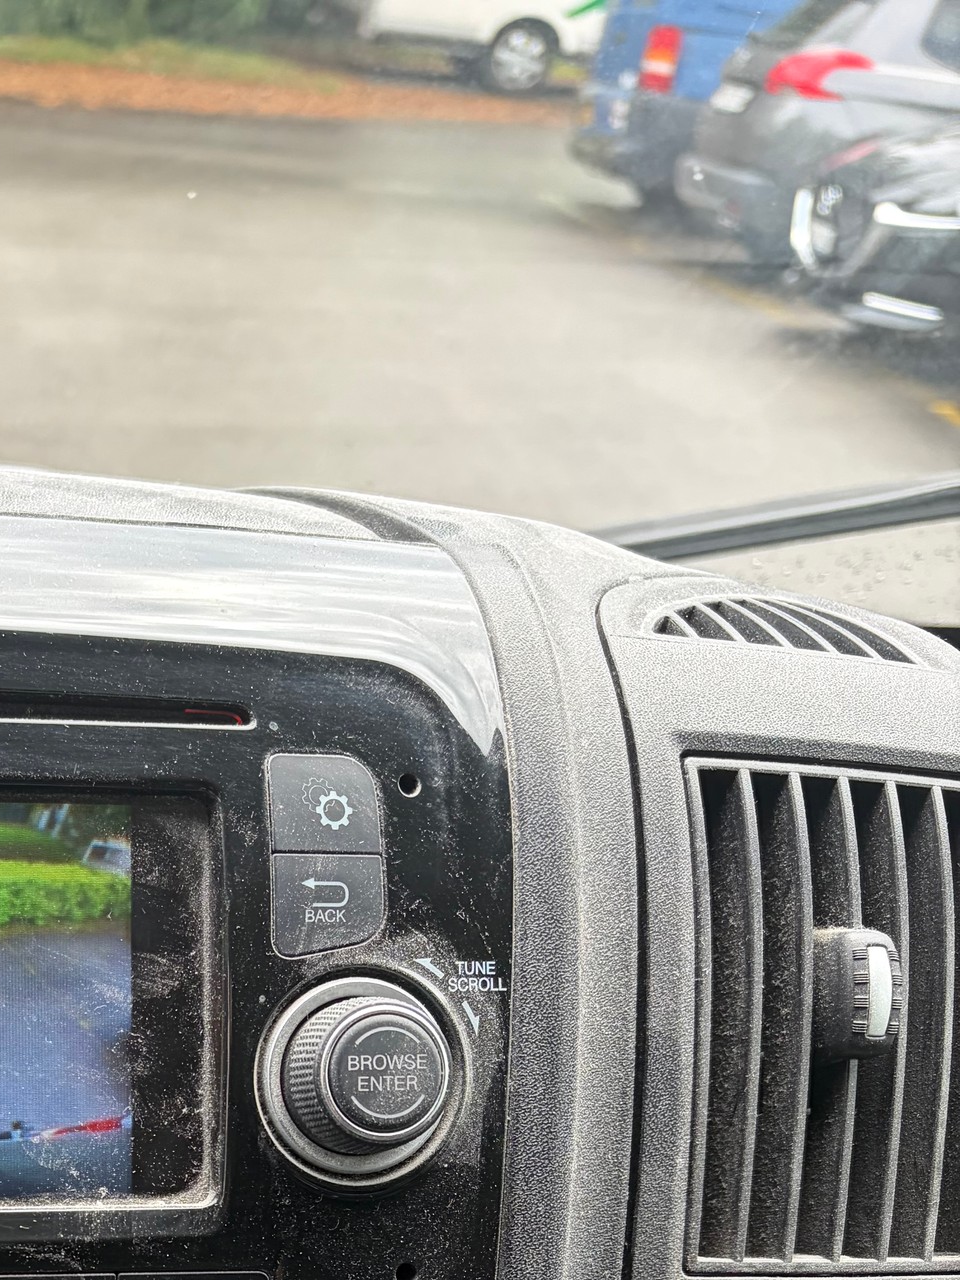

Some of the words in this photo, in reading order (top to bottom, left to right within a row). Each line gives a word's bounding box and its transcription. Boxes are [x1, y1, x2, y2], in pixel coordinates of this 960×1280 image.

[304, 909, 347, 924] BACK
[456, 961, 496, 976] TUNE
[447, 976, 508, 992] SCROLL
[347, 1054, 428, 1071] BROWSE
[357, 1074, 419, 1093] ENTER
